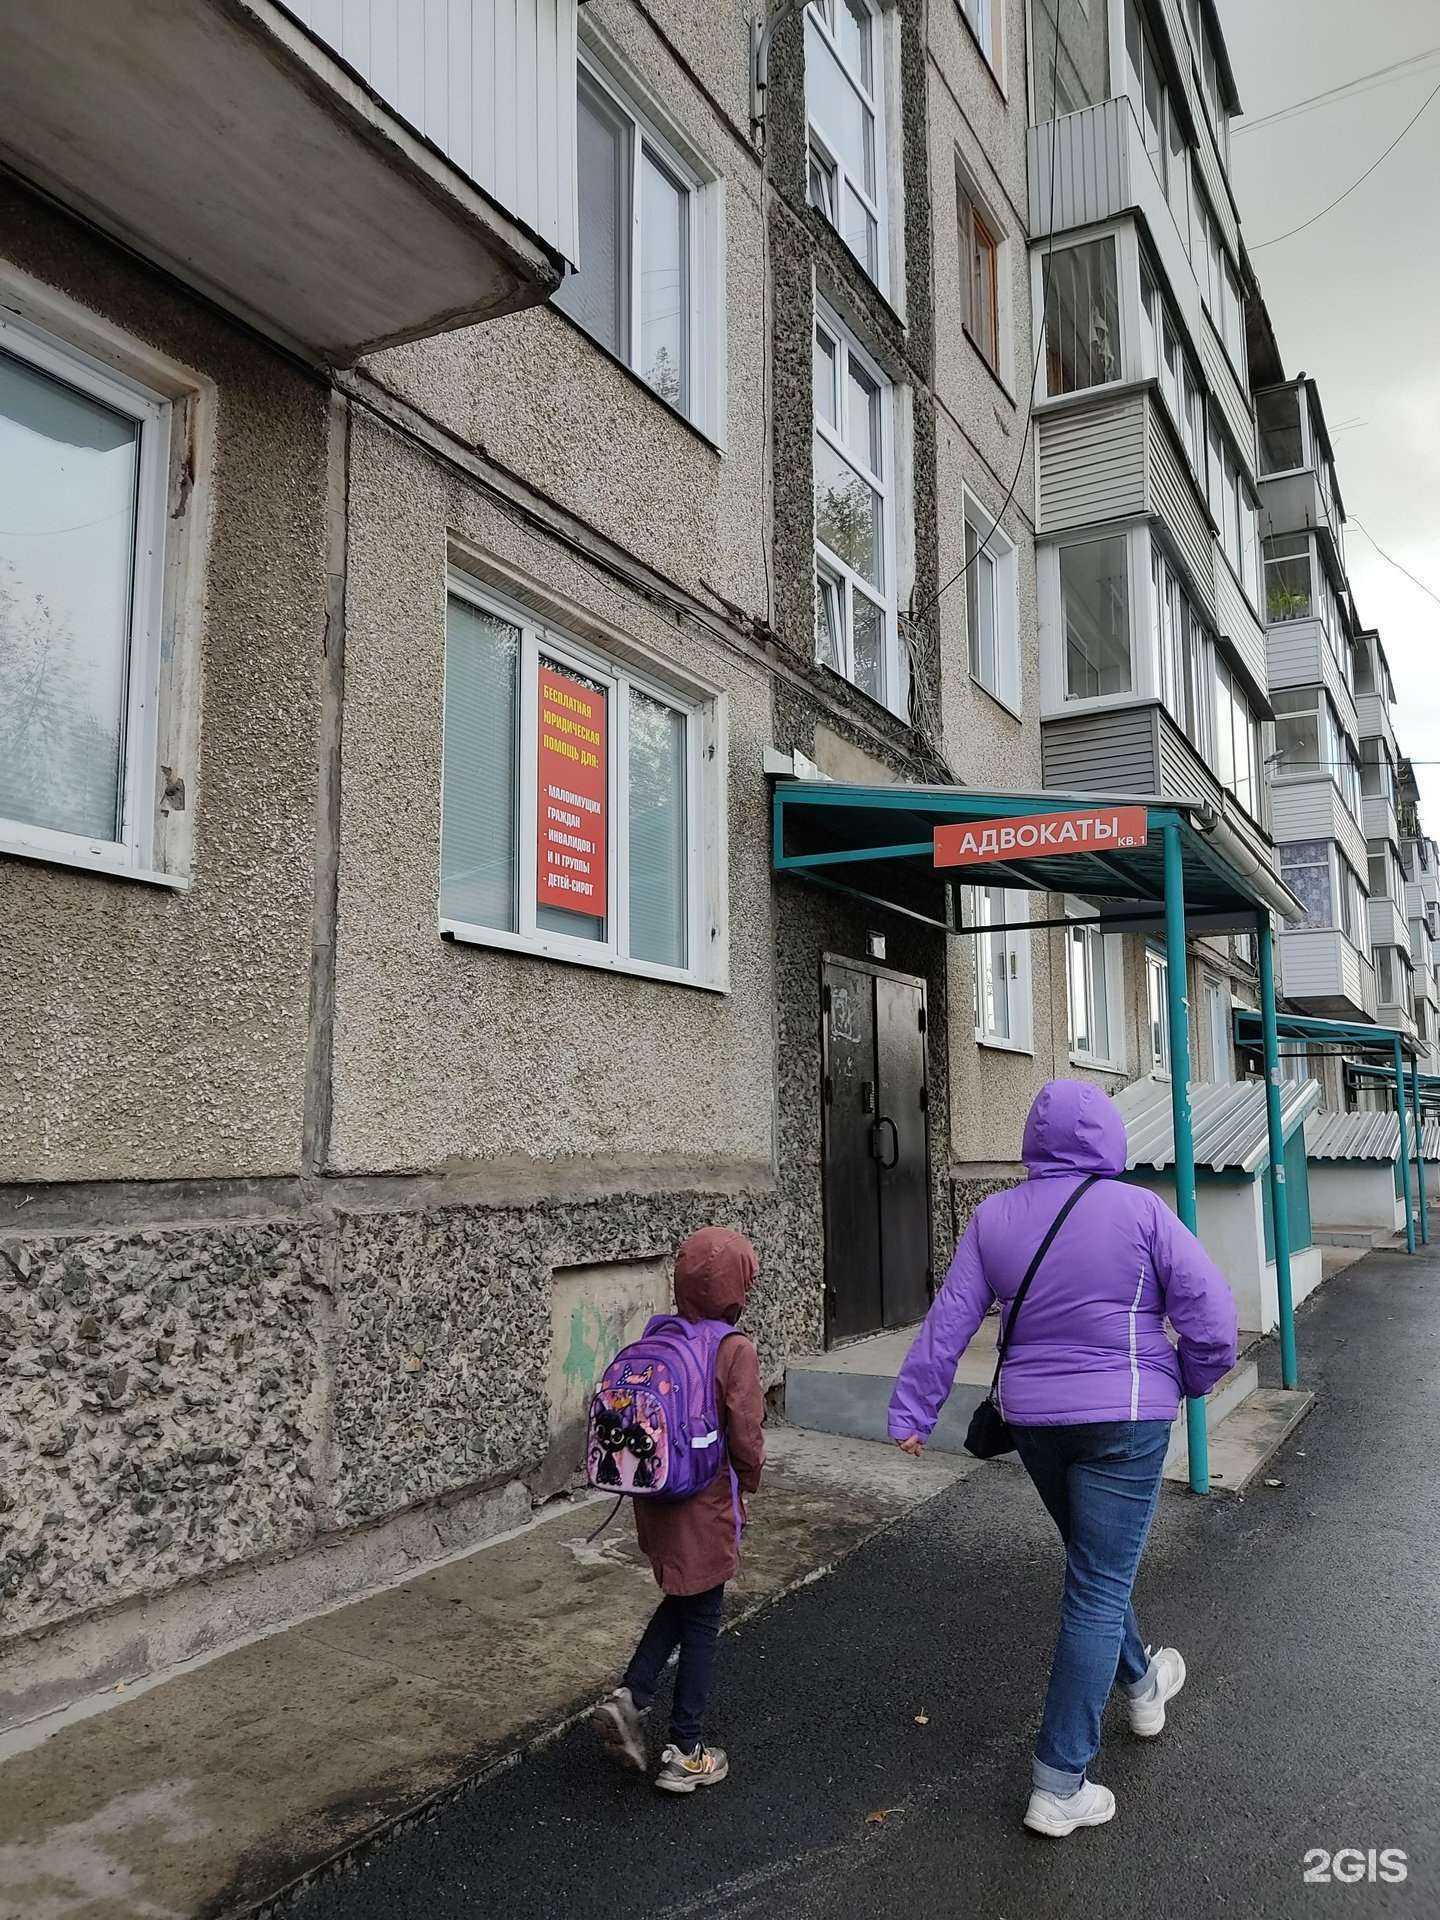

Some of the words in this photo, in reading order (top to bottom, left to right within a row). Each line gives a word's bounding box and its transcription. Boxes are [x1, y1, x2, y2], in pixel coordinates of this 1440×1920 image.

[543, 684, 592, 718] БЕСПЛАТНАЯ
[543, 709, 600, 745] ЮРИДИЧЕСКАЯ
[543, 734, 579, 760] ПОМОЩЬ
[580, 750, 599, 769] ДЛЯ:
[548, 784, 601, 814] МАЛОИМУЩИХ
[547, 806, 581, 829] ГРАЖДАН
[548, 828, 591, 853] ИНВАЛИДОВ
[959, 817, 1118, 856] АДВОКАТЫ
[547, 850, 553, 863] И
[561, 855, 591, 874] ГРУППЫ
[547, 873, 594, 896] ДЕТЕЙ-СИРОТ
